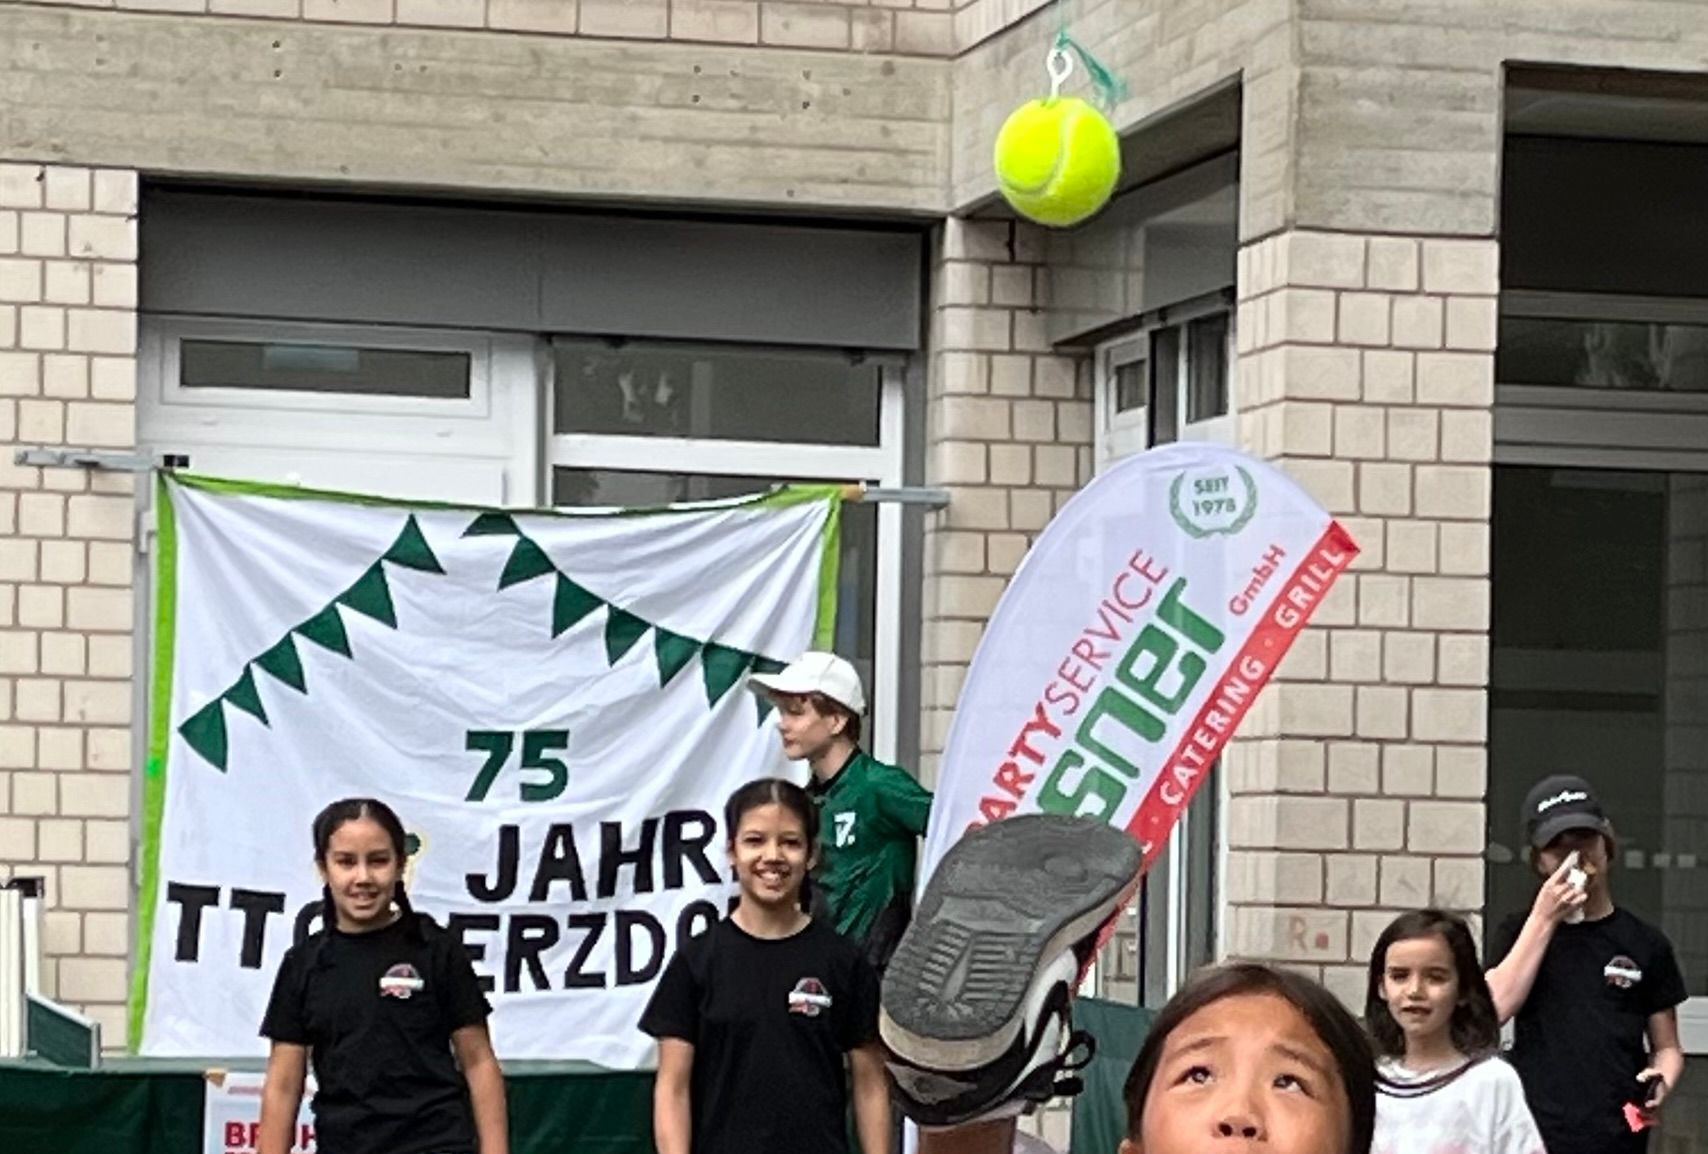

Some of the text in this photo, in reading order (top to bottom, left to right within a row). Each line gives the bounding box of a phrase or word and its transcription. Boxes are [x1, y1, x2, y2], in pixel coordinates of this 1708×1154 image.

[1194, 475, 1230, 495] SEIT
[1036, 544, 1287, 826] sner GmbH
[1160, 547, 1346, 806] CATERING GRILL
[465, 728, 570, 803] 75
[465, 809, 739, 903] JAHR
